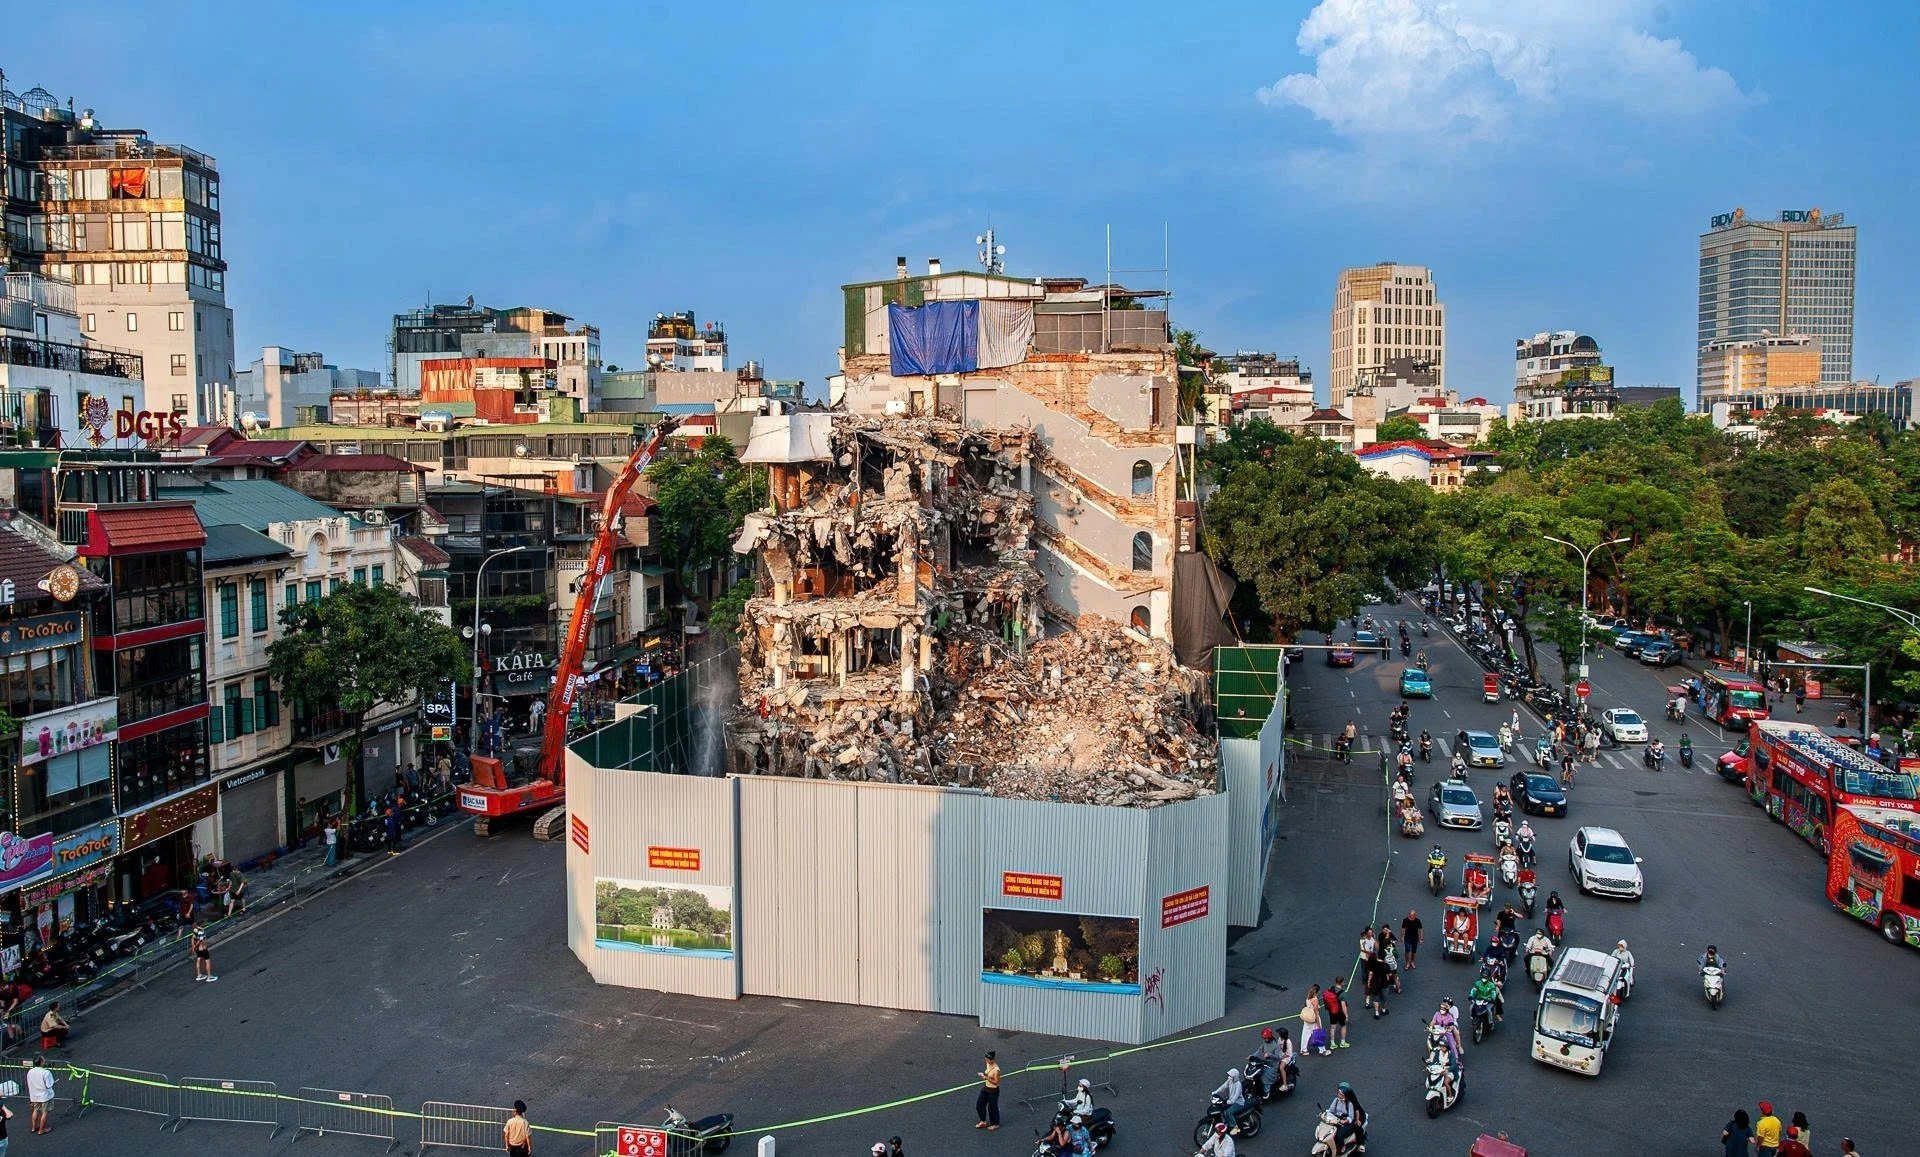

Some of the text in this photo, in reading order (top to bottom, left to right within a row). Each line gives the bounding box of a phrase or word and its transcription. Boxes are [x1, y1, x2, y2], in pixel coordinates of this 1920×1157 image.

[1711, 212, 1735, 227] BIDV
[1782, 210, 1810, 222] BIDV
[116, 409, 182, 440] DGTS
[578, 608, 589, 643] HITACHI
[495, 653, 545, 672] KAFA
[508, 671, 533, 683] Café
[426, 703, 451, 714] SPA
[226, 769, 265, 789] Vietcombank
[1853, 798, 1914, 810] HANOI CITY TOUR
